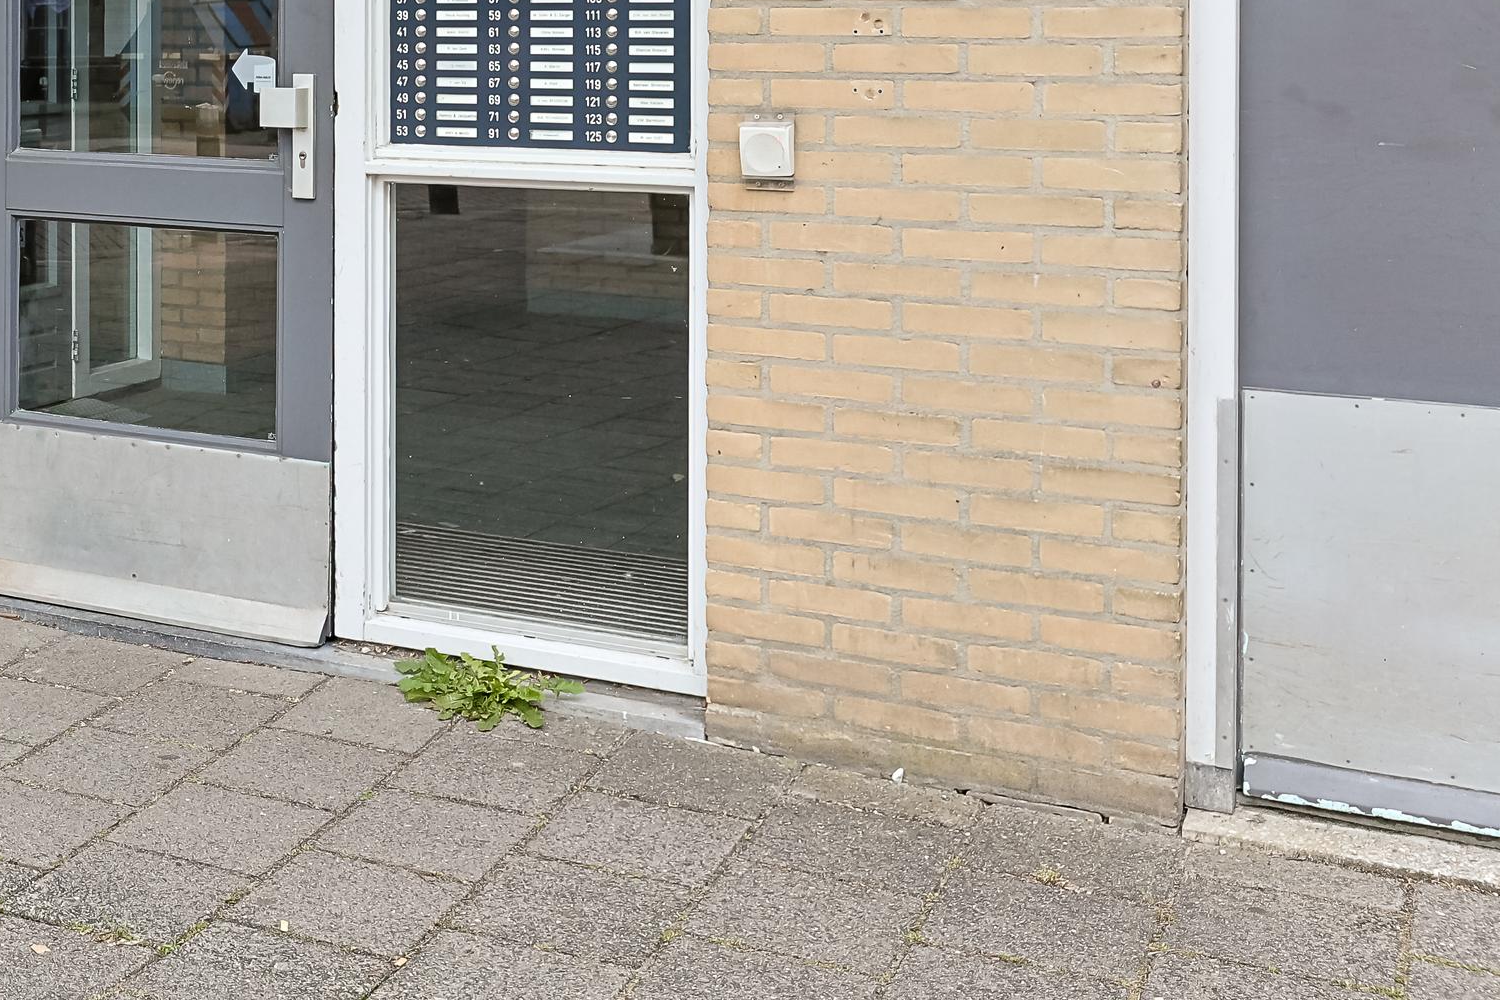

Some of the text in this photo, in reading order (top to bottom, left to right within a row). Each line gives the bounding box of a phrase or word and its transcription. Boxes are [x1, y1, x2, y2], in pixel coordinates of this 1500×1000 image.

[396, 9, 409, 21] 39
[488, 9, 501, 21] 59
[585, 9, 601, 21] 111
[396, 26, 407, 37] 41
[488, 26, 499, 38] 61
[585, 26, 602, 39] 113
[396, 43, 409, 54] 43
[488, 43, 501, 55] 63
[585, 44, 602, 56] 115
[396, 59, 409, 71] 45
[488, 60, 501, 72] 65
[584, 61, 601, 73] 117
[396, 75, 409, 87] 47
[488, 77, 501, 89] 67
[585, 78, 602, 91] 119
[396, 92, 409, 104] 49
[488, 94, 501, 106] 69
[585, 96, 601, 108] 121
[396, 108, 407, 120] 51
[488, 110, 500, 122] 71
[584, 113, 603, 125] 123
[396, 125, 409, 137] 53
[488, 127, 500, 139] 91
[584, 130, 603, 143] 125
